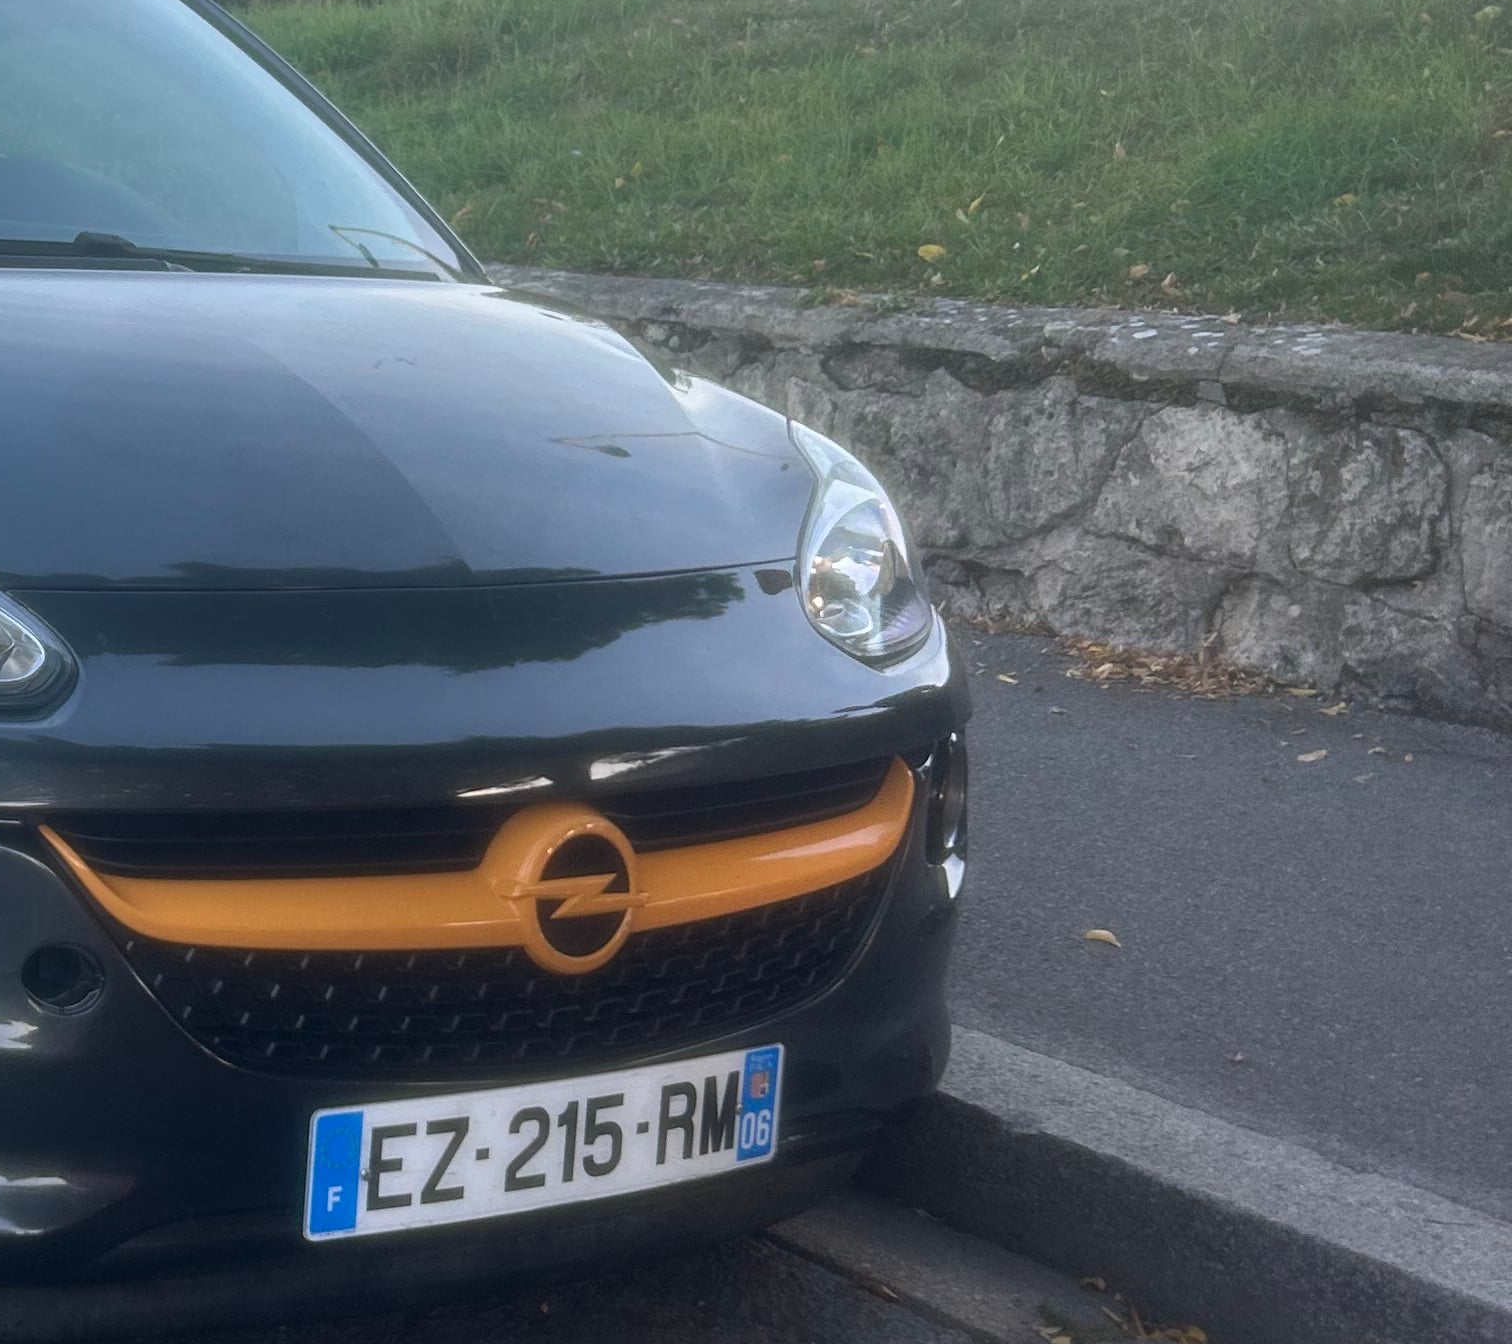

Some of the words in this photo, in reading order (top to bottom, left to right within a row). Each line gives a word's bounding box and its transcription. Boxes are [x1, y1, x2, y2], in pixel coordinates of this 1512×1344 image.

[366, 1070, 740, 1212] EZ-215-RM
[741, 1108, 772, 1150] 06
[326, 1185, 343, 1213] F
